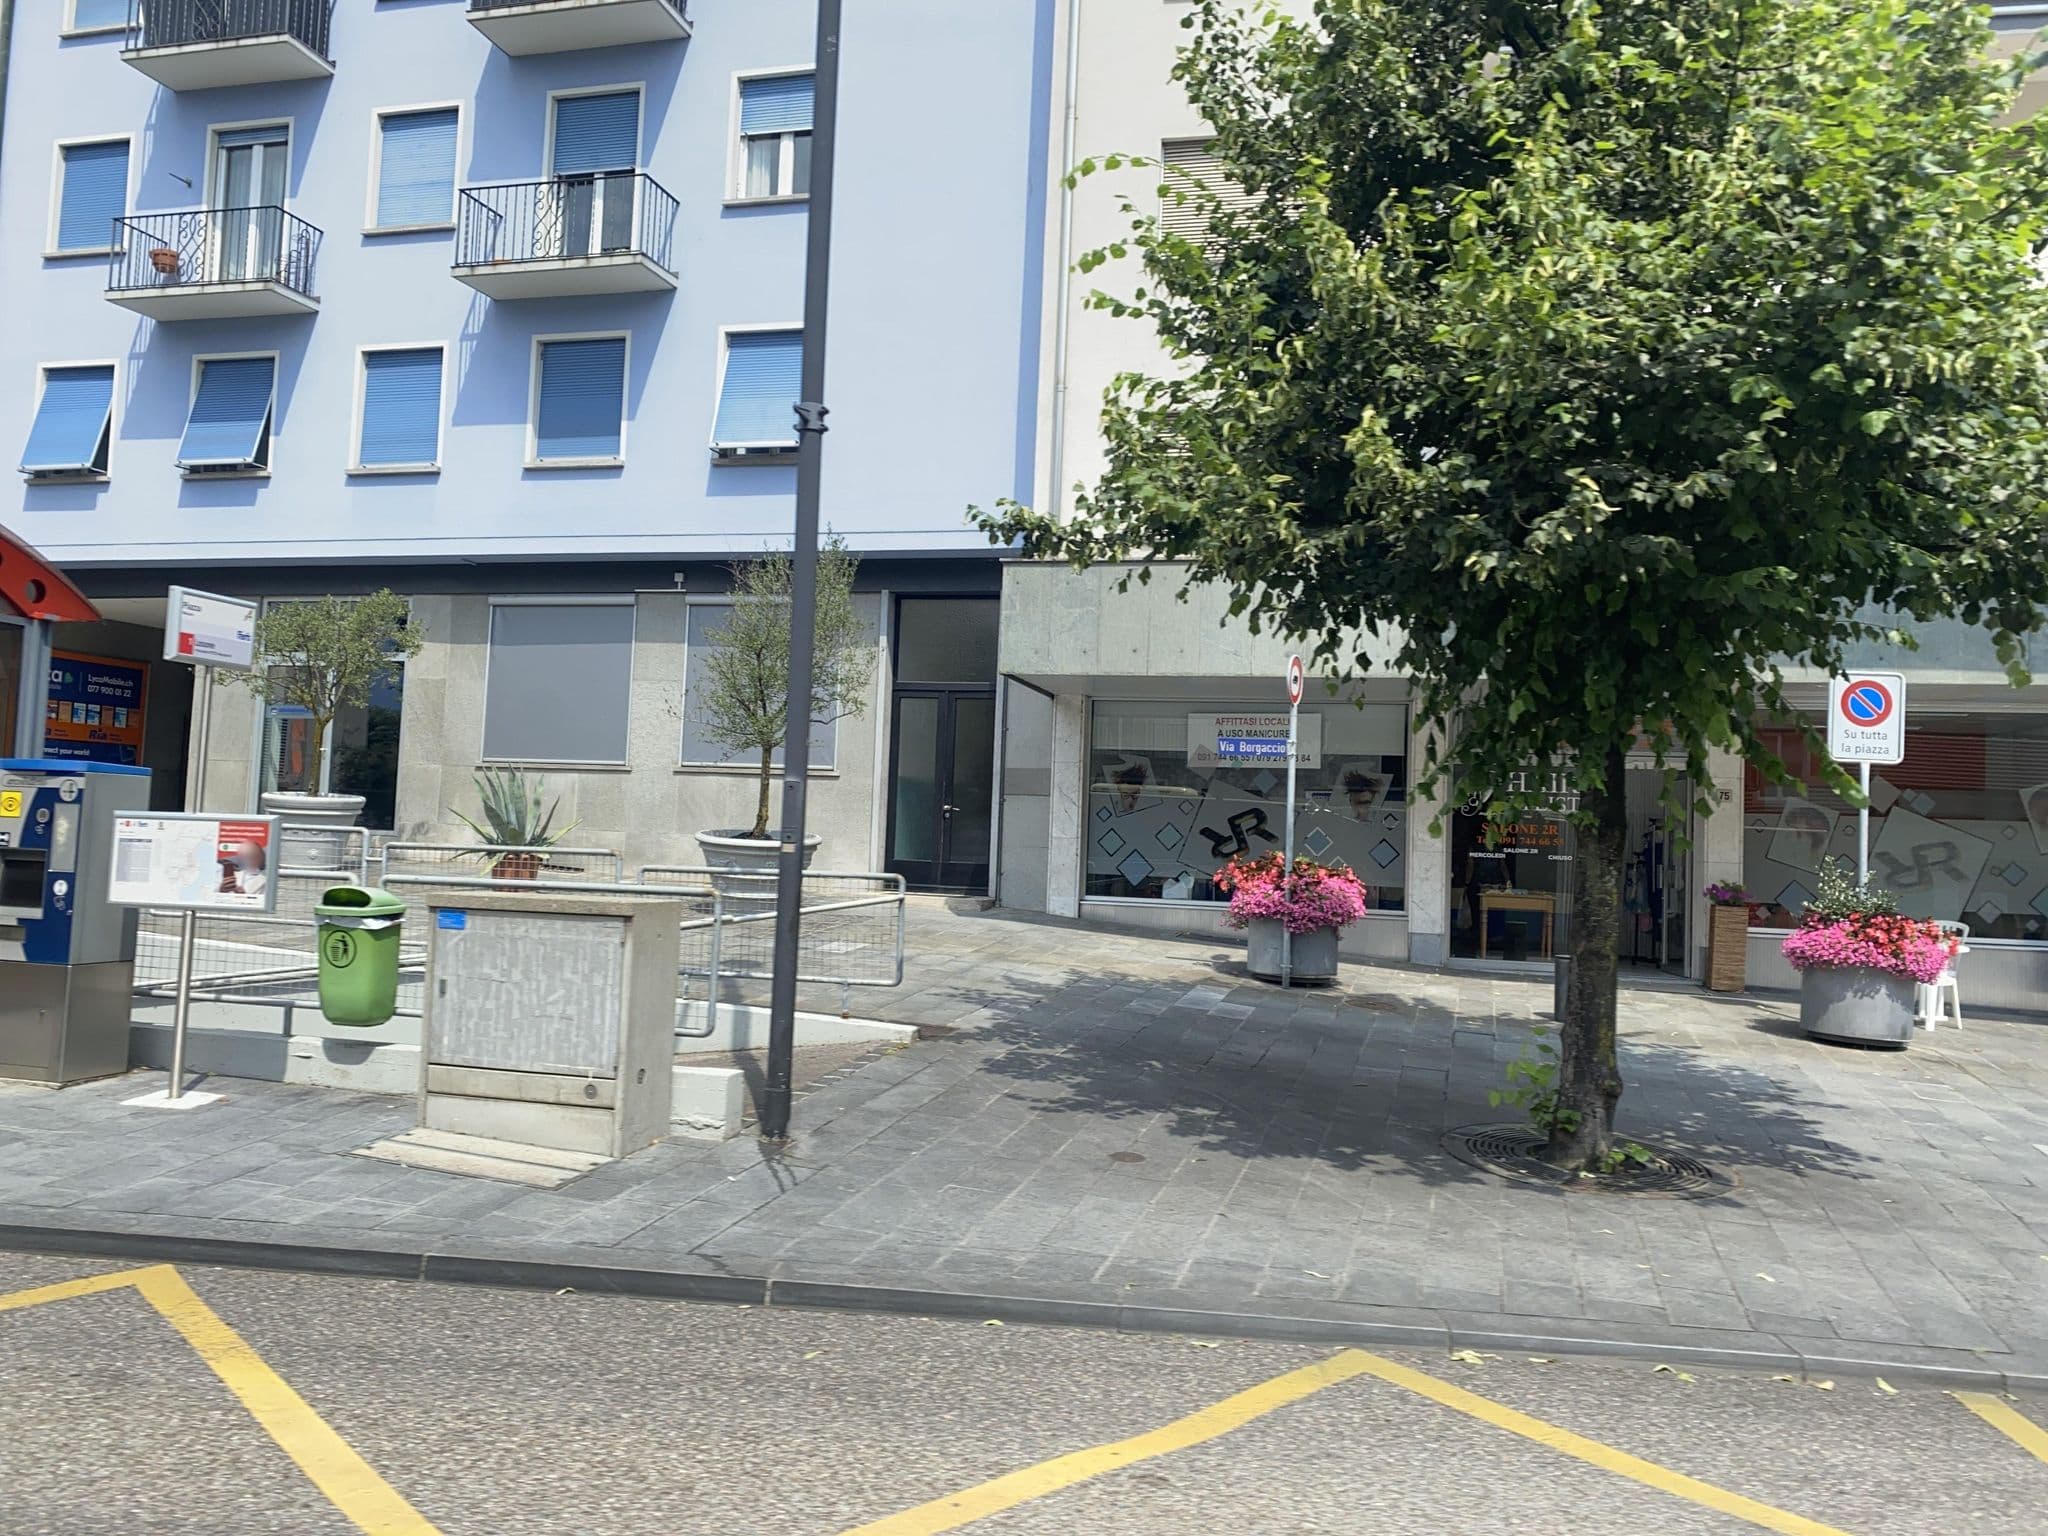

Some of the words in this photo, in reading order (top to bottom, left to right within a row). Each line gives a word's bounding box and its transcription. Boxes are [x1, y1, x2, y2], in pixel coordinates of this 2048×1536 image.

[1215, 717, 1257, 726] AFFITTASI
[1217, 729, 1224, 738] A
[1225, 729, 1243, 738] USO
[1245, 729, 1290, 738] MANICURE
[1844, 729, 1857, 739] Su
[1860, 730, 1888, 741] tutta
[1220, 741, 1235, 752] Via
[1240, 741, 1286, 755] Borgaccio
[1841, 743, 1852, 753] la
[1855, 743, 1890, 755] piazza
[1719, 791, 1730, 801] 75
